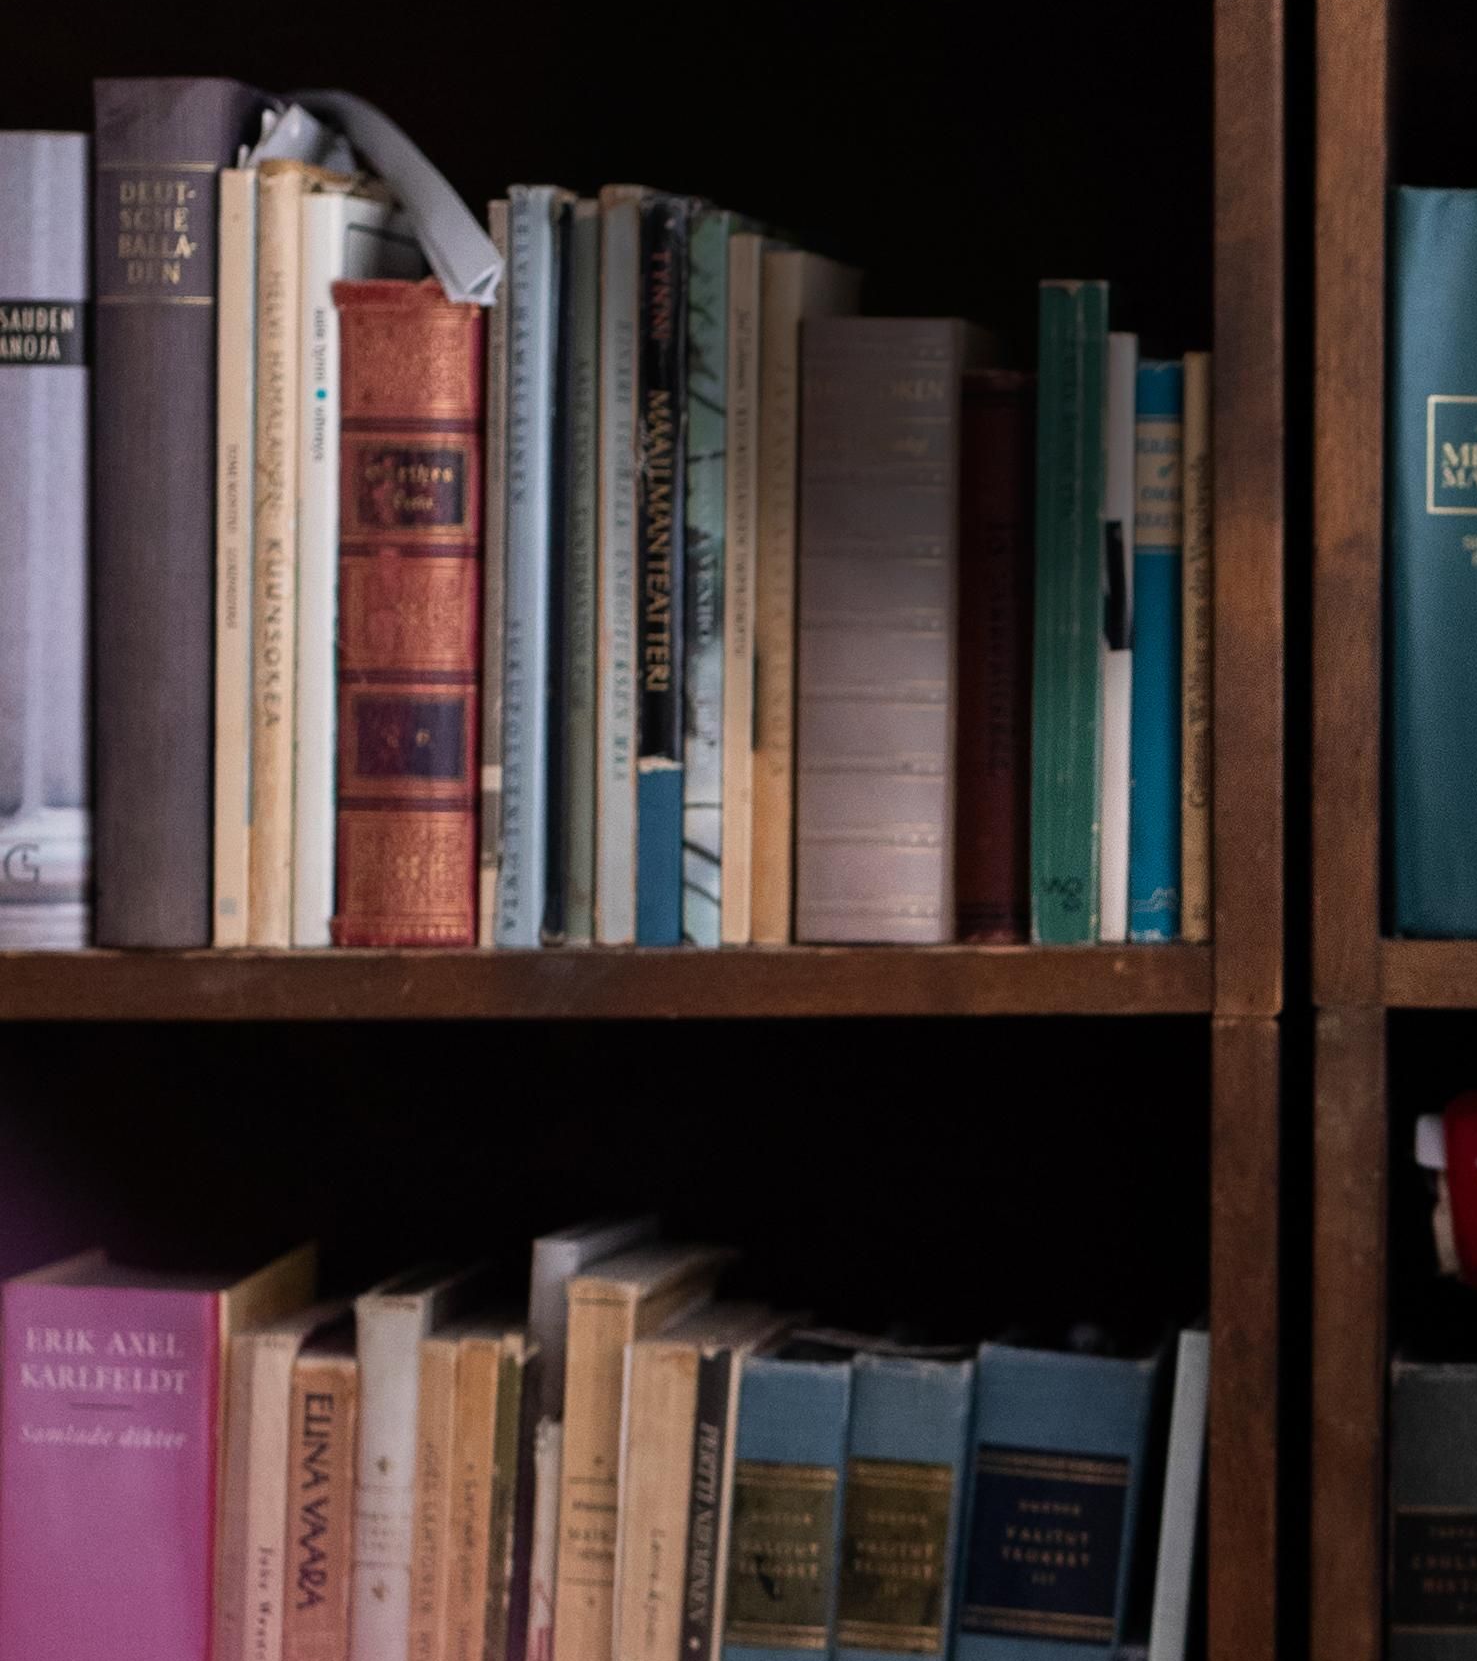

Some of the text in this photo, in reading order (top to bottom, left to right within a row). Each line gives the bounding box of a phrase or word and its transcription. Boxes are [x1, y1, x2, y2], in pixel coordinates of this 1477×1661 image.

[643, 389, 671, 693] MAAILMANTEATTERI
[26, 1328, 185, 1359] ERIK AXEL
[19, 1363, 190, 1396] KARLFELDT
[296, 1502, 332, 1609] VAARA
